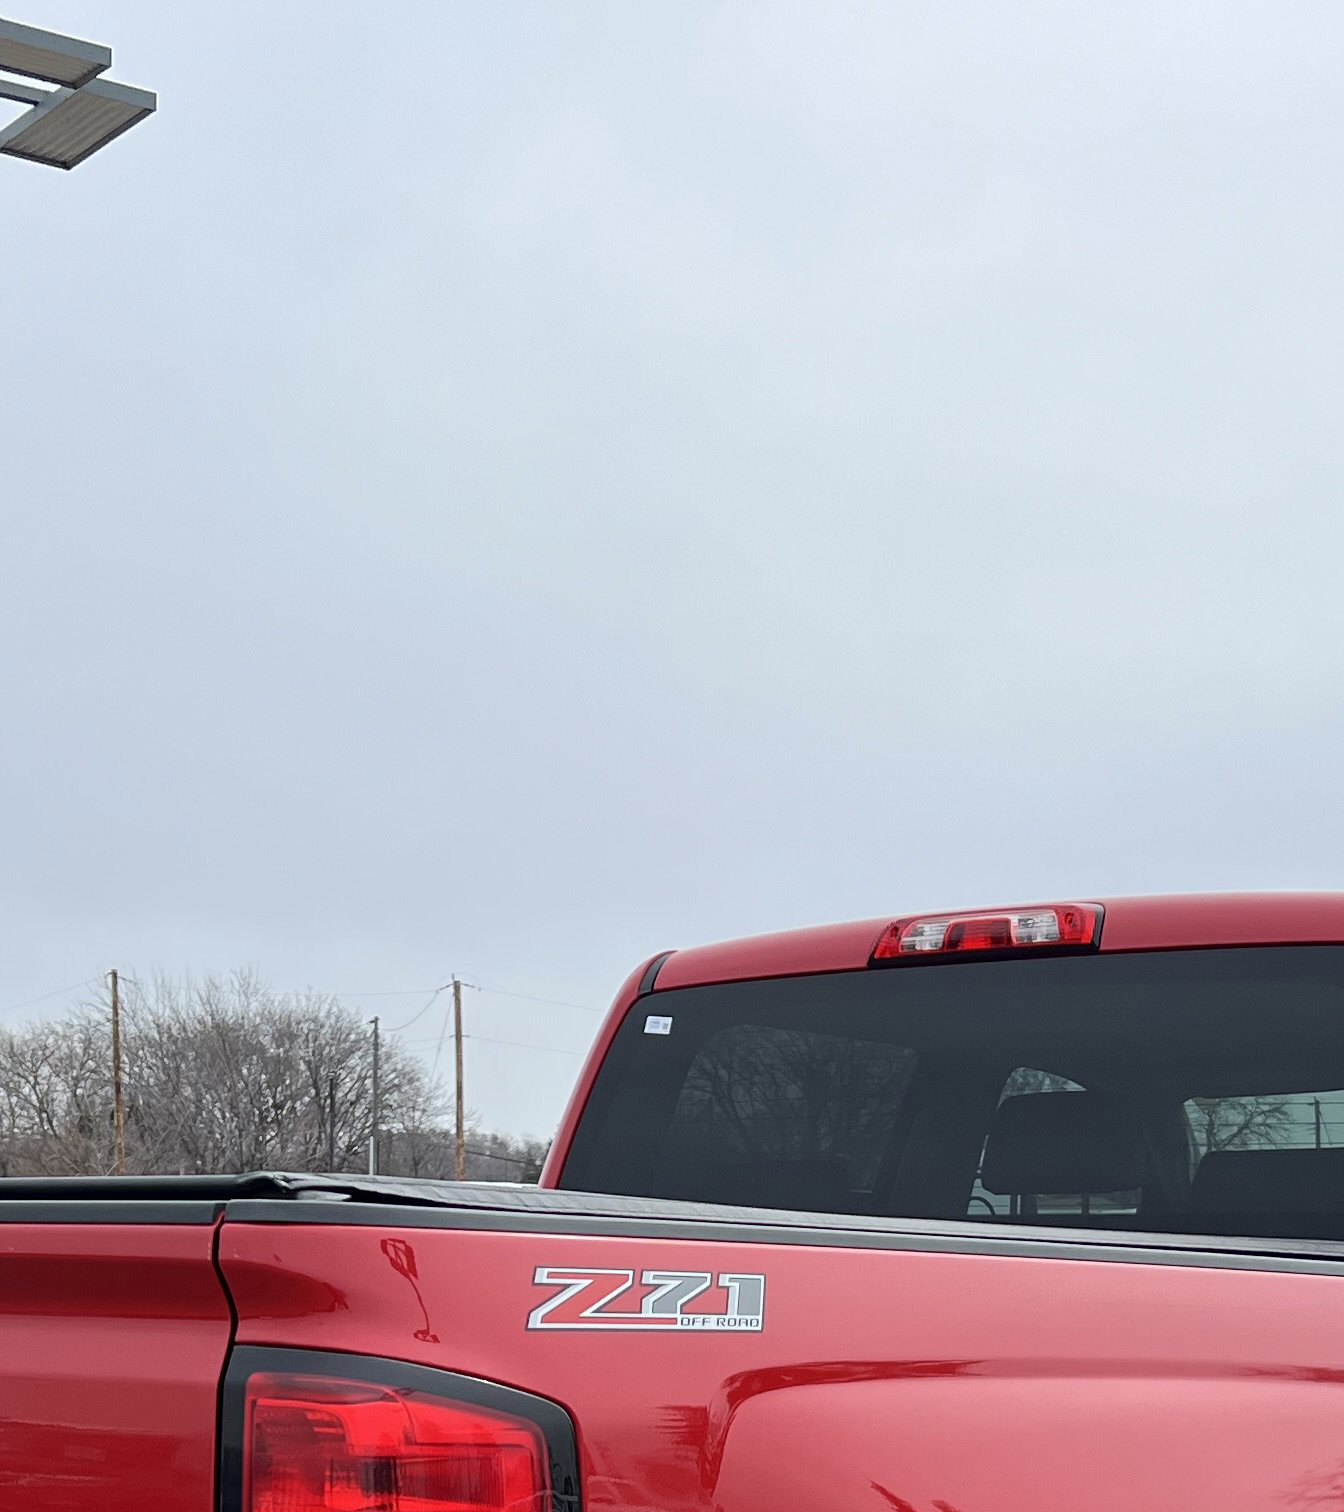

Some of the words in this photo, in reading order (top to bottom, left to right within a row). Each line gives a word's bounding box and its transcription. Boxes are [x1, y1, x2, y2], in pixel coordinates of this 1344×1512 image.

[526, 1266, 765, 1331] Z71
[680, 1316, 712, 1327] OFF
[716, 1317, 760, 1328] ROAD
